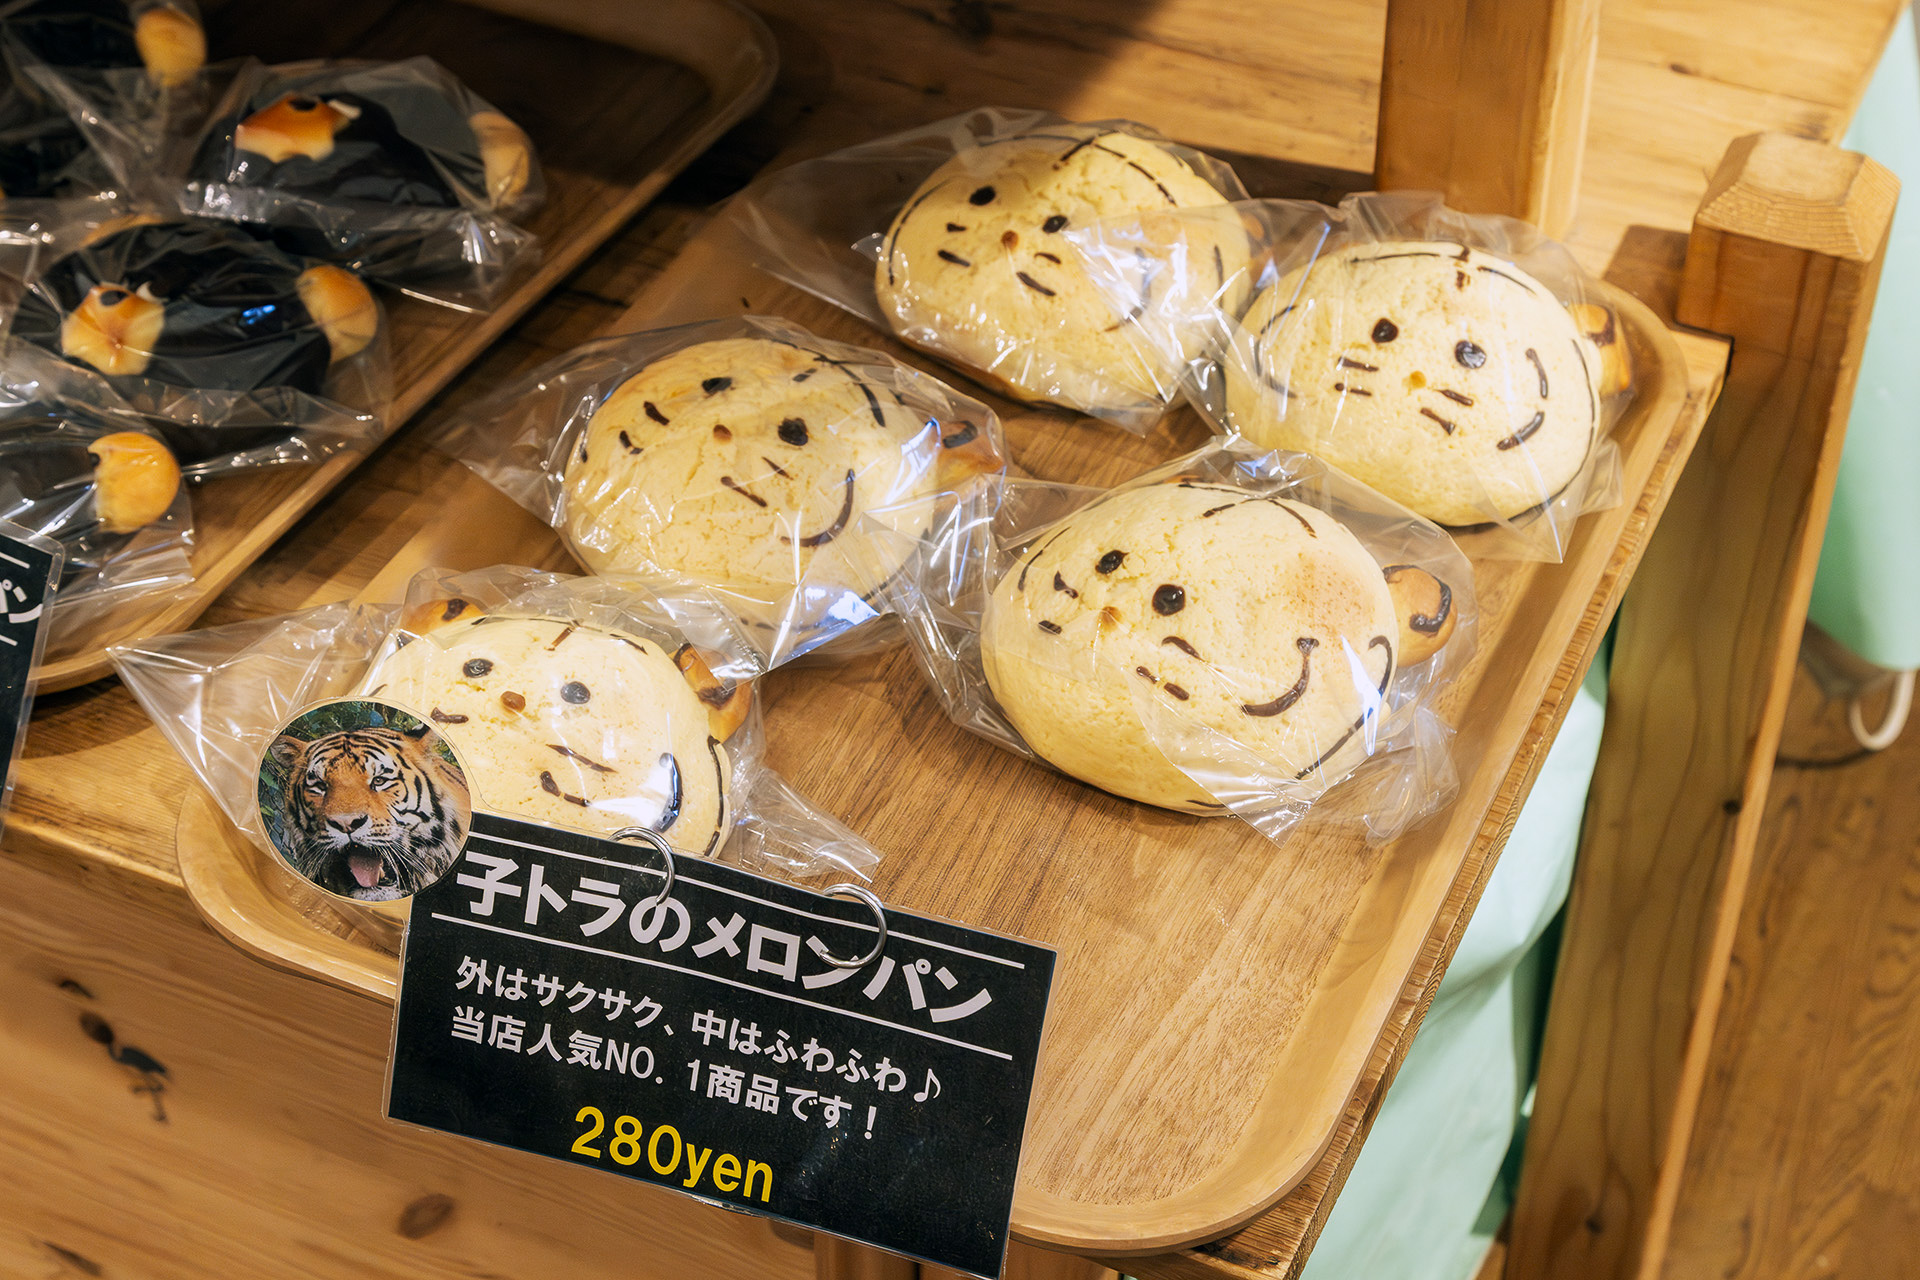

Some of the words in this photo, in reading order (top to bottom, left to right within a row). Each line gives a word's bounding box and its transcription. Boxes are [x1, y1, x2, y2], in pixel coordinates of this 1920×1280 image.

[456, 850, 992, 1023] 子トラのメロンパン
[570, 1106, 774, 1202] 280yen
